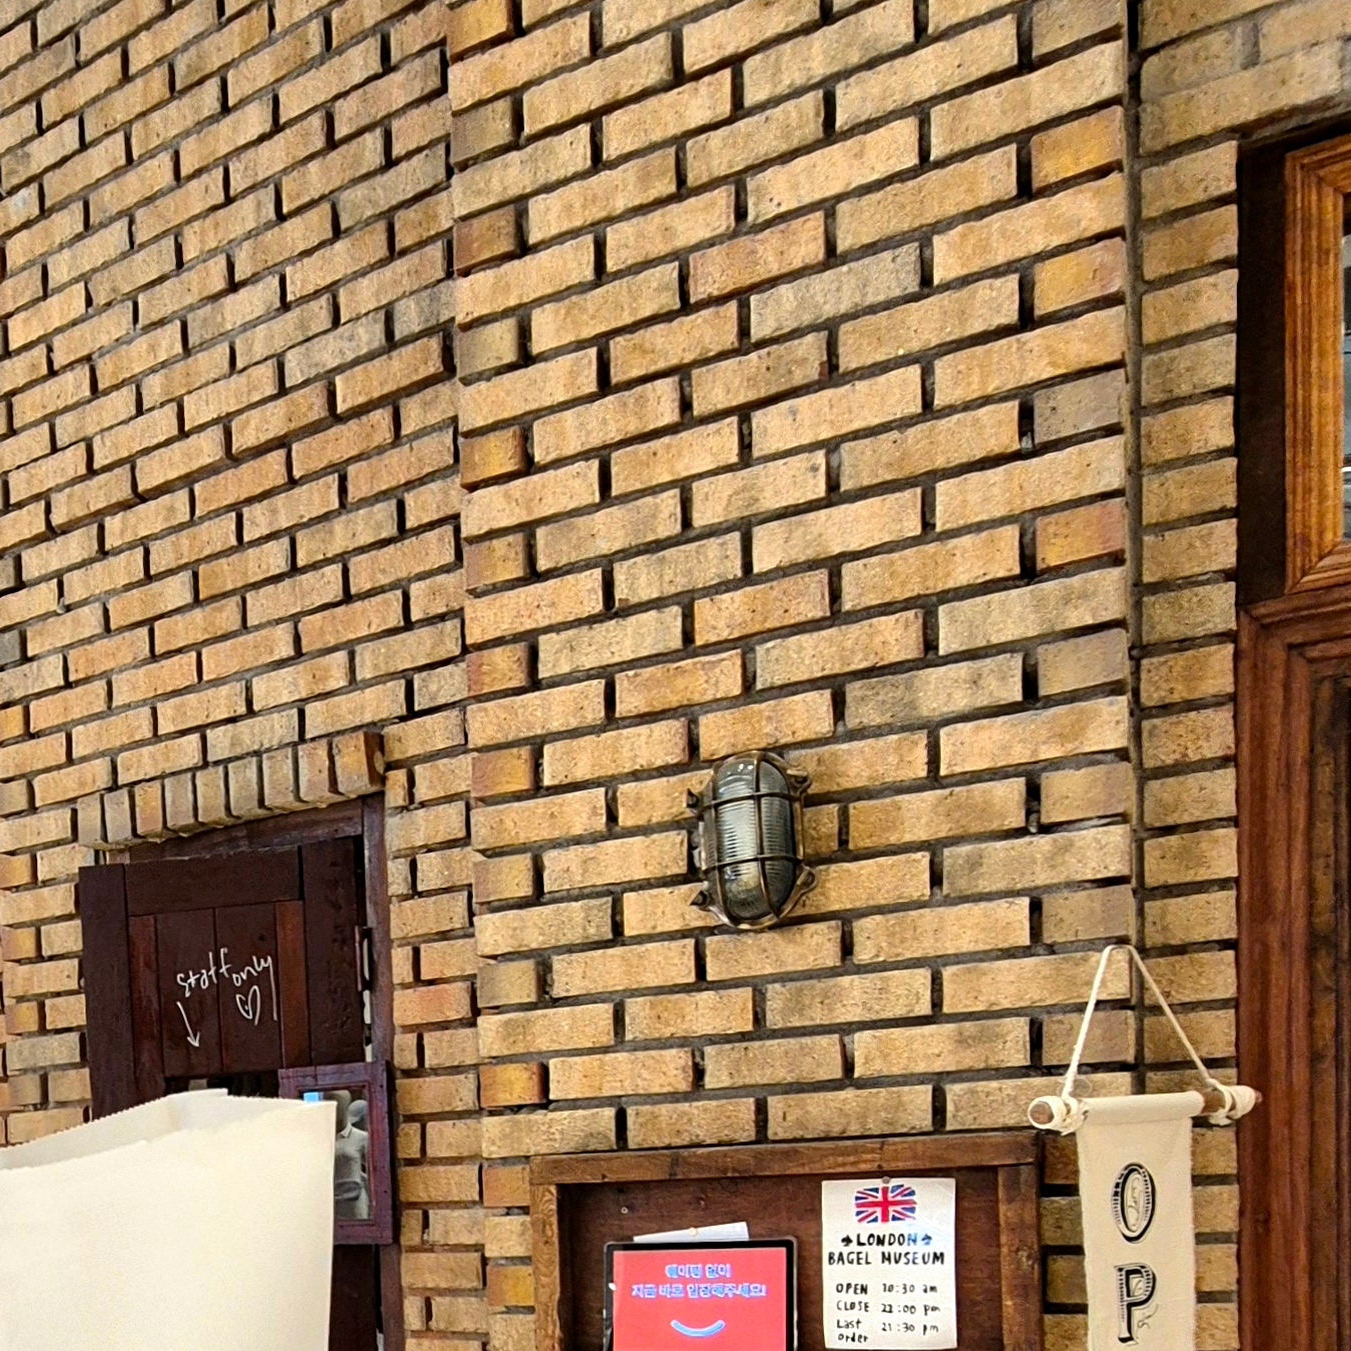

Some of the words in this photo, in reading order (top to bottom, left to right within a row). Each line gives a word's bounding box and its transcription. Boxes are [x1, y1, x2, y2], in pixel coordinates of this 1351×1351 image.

[856, 1233, 917, 1246] LONDON
[828, 1251, 872, 1265] BAGEL
[881, 1251, 945, 1265] MUSEUM
[631, 1283, 657, 1299] 지금
[659, 1283, 684, 1299] 바로
[836, 1282, 868, 1295] OPEN
[882, 1283, 915, 1294] 10:30
[837, 1300, 870, 1312] CLOSE
[881, 1303, 916, 1314] 22:00
[837, 1318, 862, 1329] Last
[881, 1322, 915, 1333] 21:30
[923, 1324, 938, 1336] pm
